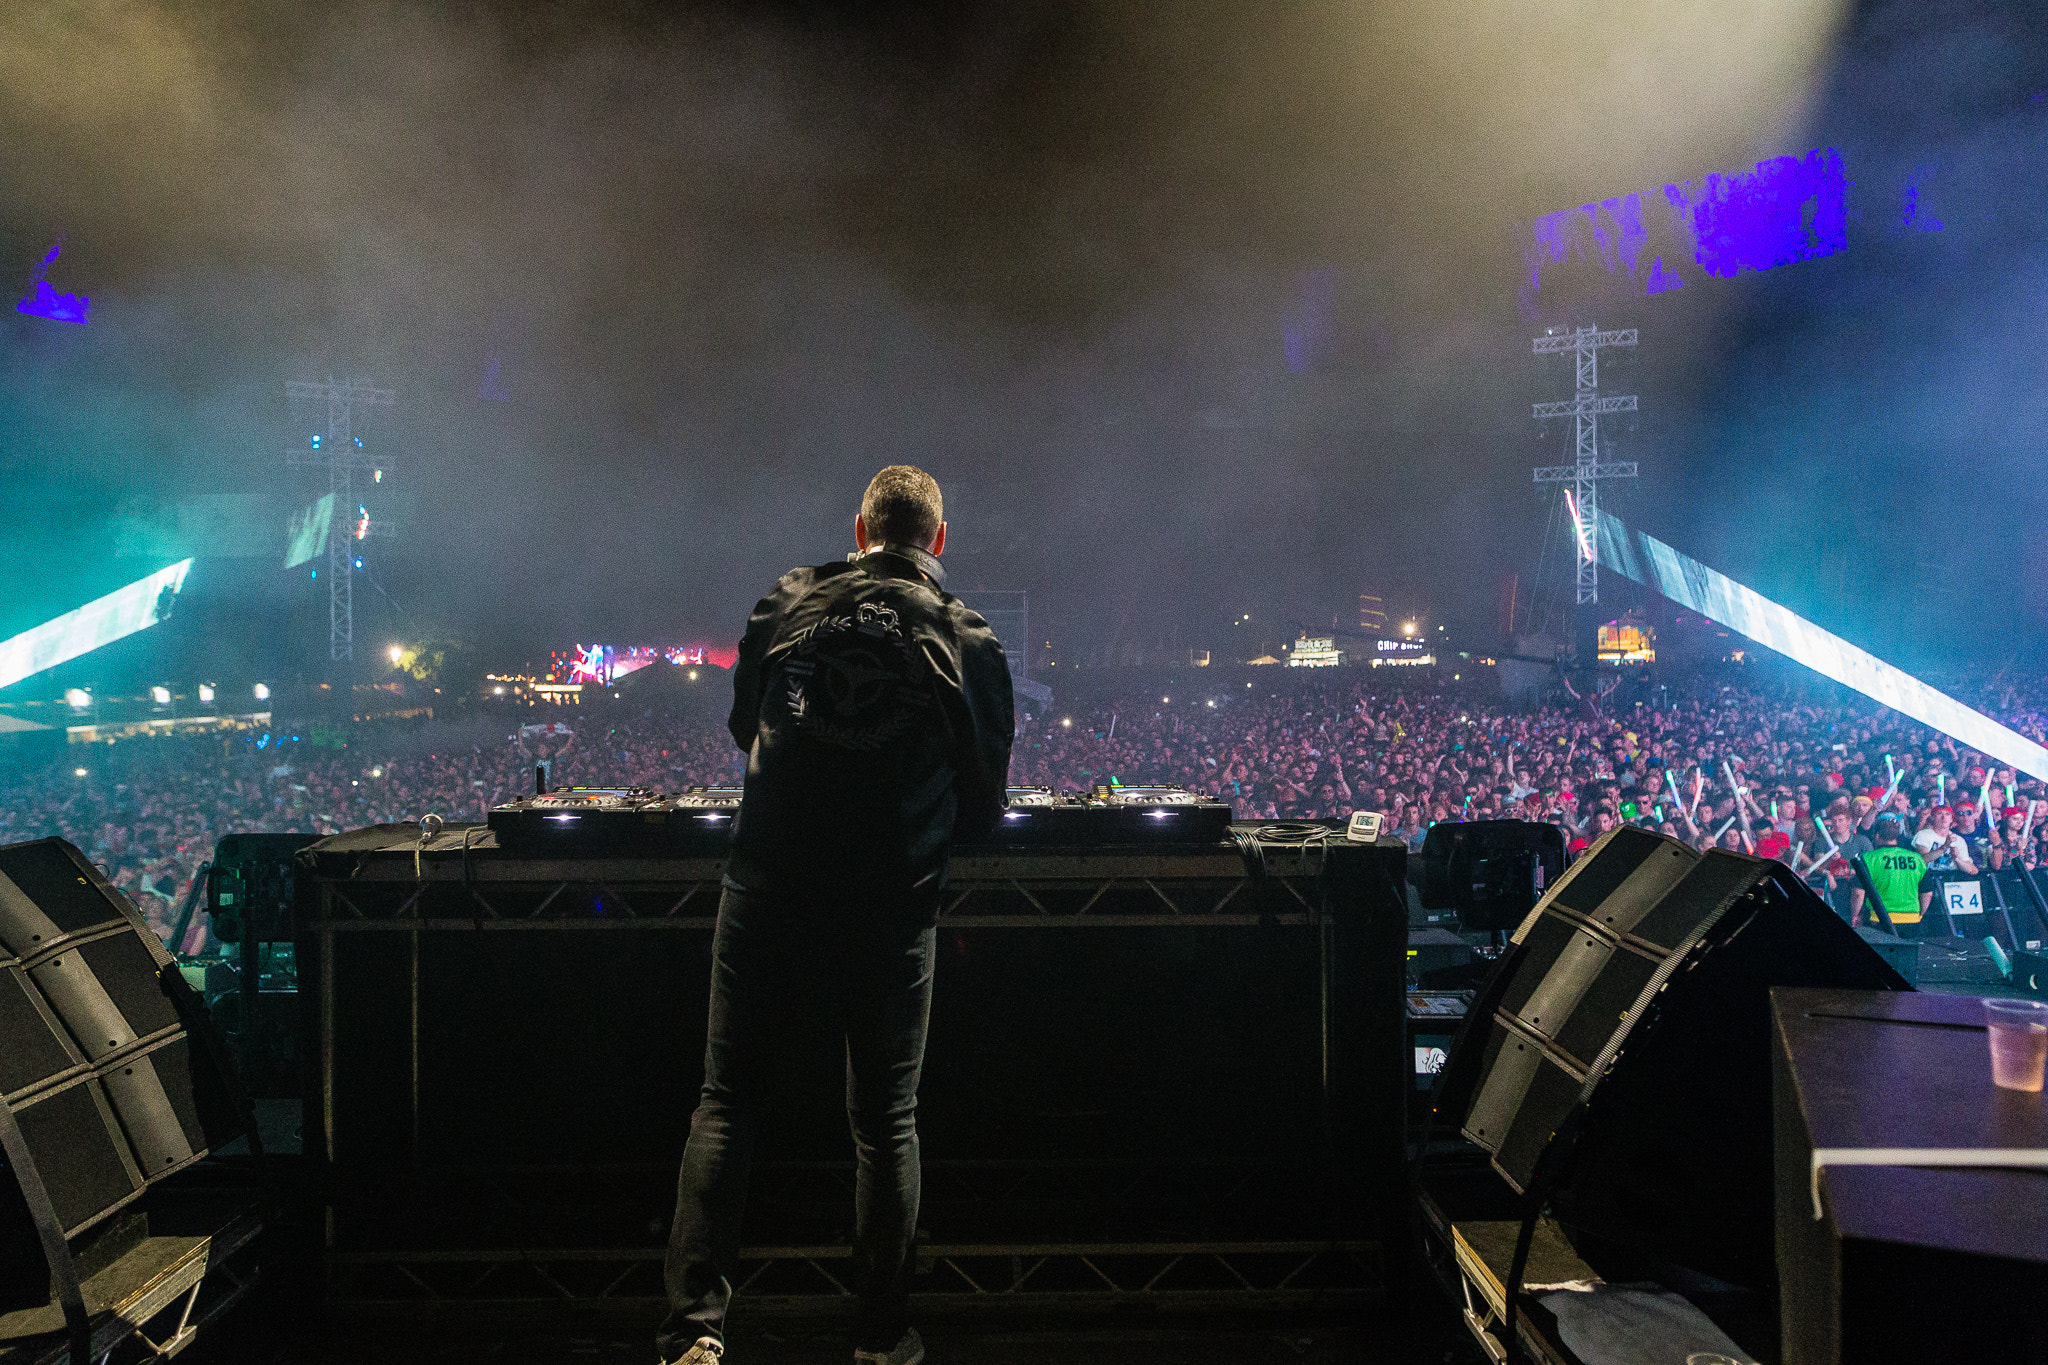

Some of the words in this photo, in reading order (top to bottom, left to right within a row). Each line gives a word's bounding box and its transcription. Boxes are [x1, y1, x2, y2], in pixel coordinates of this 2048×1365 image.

[1377, 640, 1398, 651] CHIP
[1883, 855, 1916, 870] 2185
[1951, 894, 1964, 909] R
[1969, 893, 1979, 908] 4
